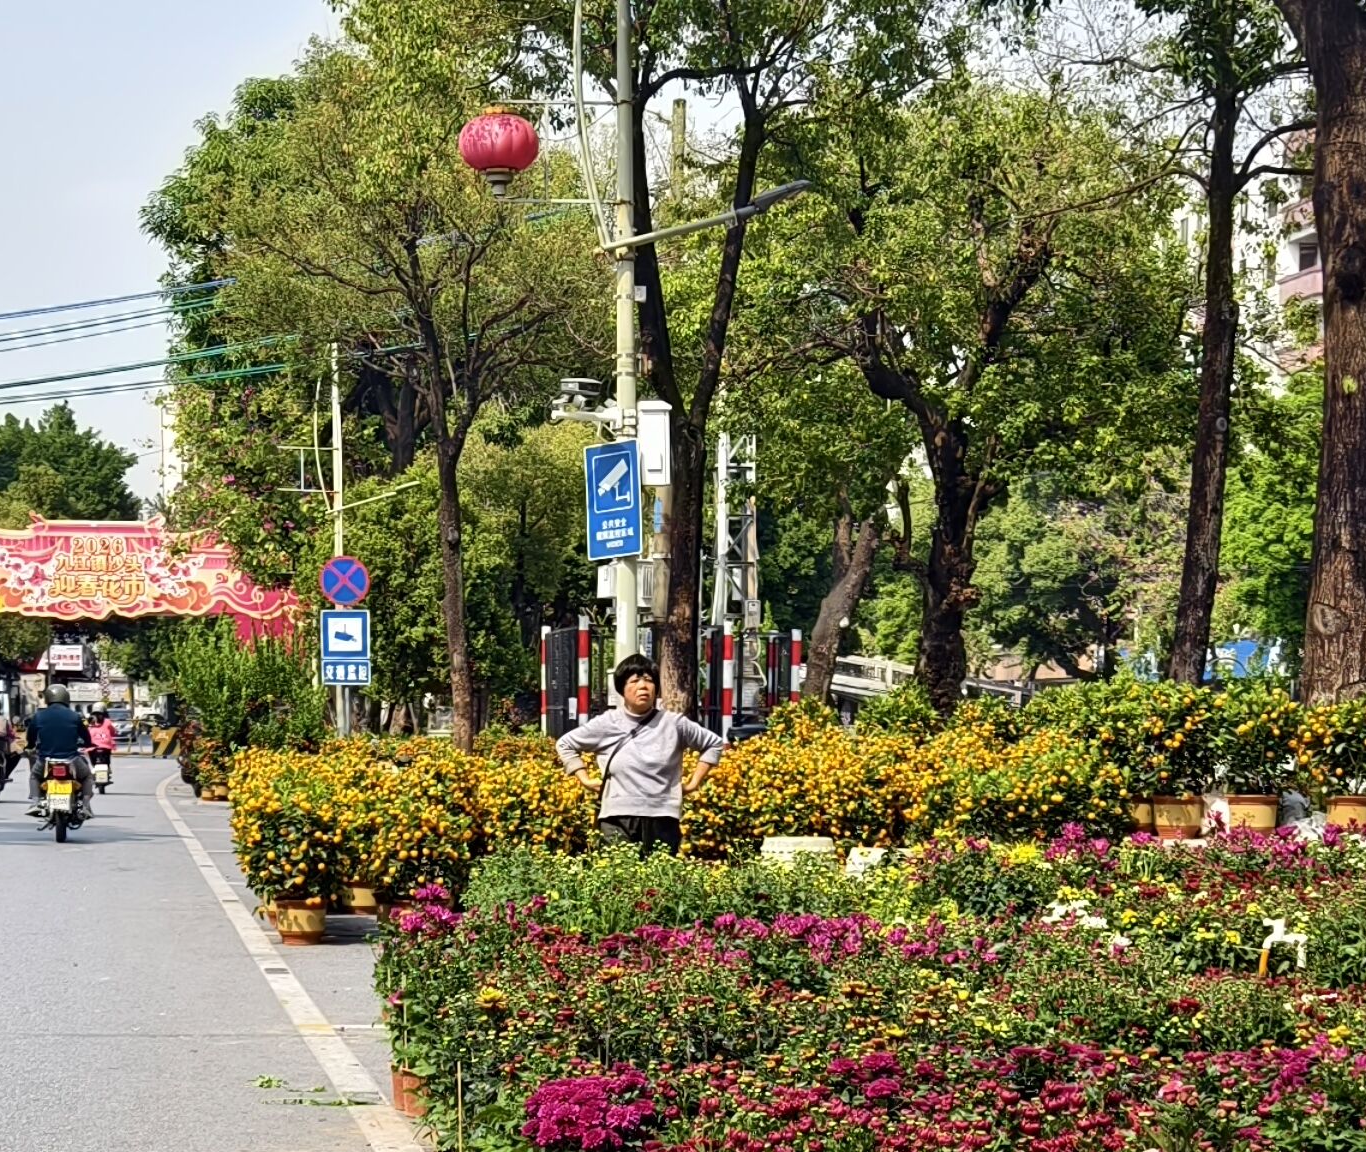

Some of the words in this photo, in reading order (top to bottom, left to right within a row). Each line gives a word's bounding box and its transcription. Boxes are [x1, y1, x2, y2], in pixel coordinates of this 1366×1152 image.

[73, 537, 124, 554] 2026
[55, 554, 143, 573] 九江镇沙头
[48, 574, 146, 605] 迎春花市
